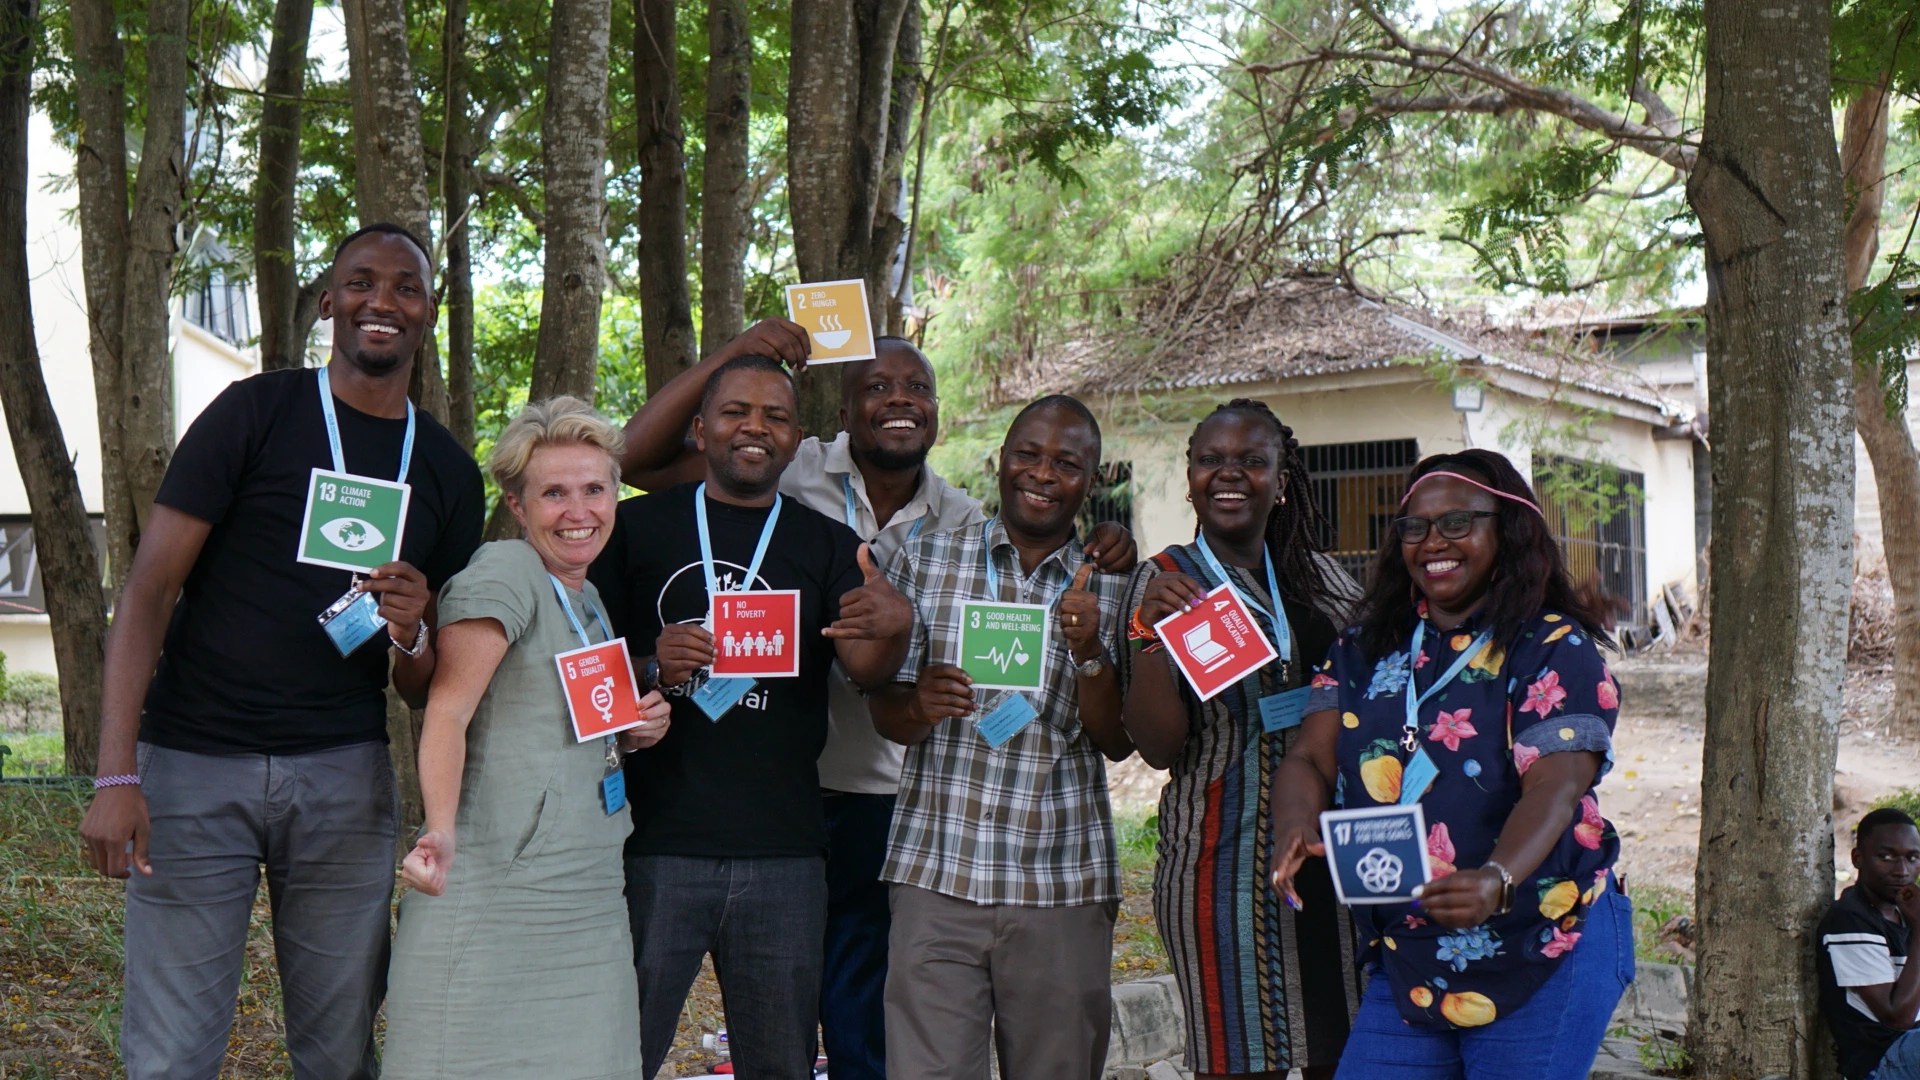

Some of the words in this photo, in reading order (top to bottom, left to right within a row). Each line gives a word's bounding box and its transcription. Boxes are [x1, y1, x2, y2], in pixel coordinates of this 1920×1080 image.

[797, 293, 807, 310] 2
[811, 291, 826, 300] ZERO
[812, 299, 837, 308] HUNGER
[319, 482, 337, 502] 13
[340, 485, 372, 499] CLIMATE
[339, 495, 366, 508] ACTION
[722, 601, 729, 619] 1
[736, 600, 747, 609] NO
[1213, 600, 1231, 612] 4
[736, 610, 766, 619] POVERTY
[971, 611, 981, 629] 3
[986, 612, 1005, 621] GOOD
[1006, 613, 1031, 622] HEALTH
[985, 622, 1000, 630] AND
[1001, 622, 1041, 633] WELL-BEING
[1228, 609, 1250, 635] QUALITY
[1220, 614, 1247, 648] EDUCATION
[578, 655, 600, 667] GENDER
[566, 661, 577, 680] 5
[580, 663, 606, 677] EQUALITY
[1334, 822, 1351, 846] 17
